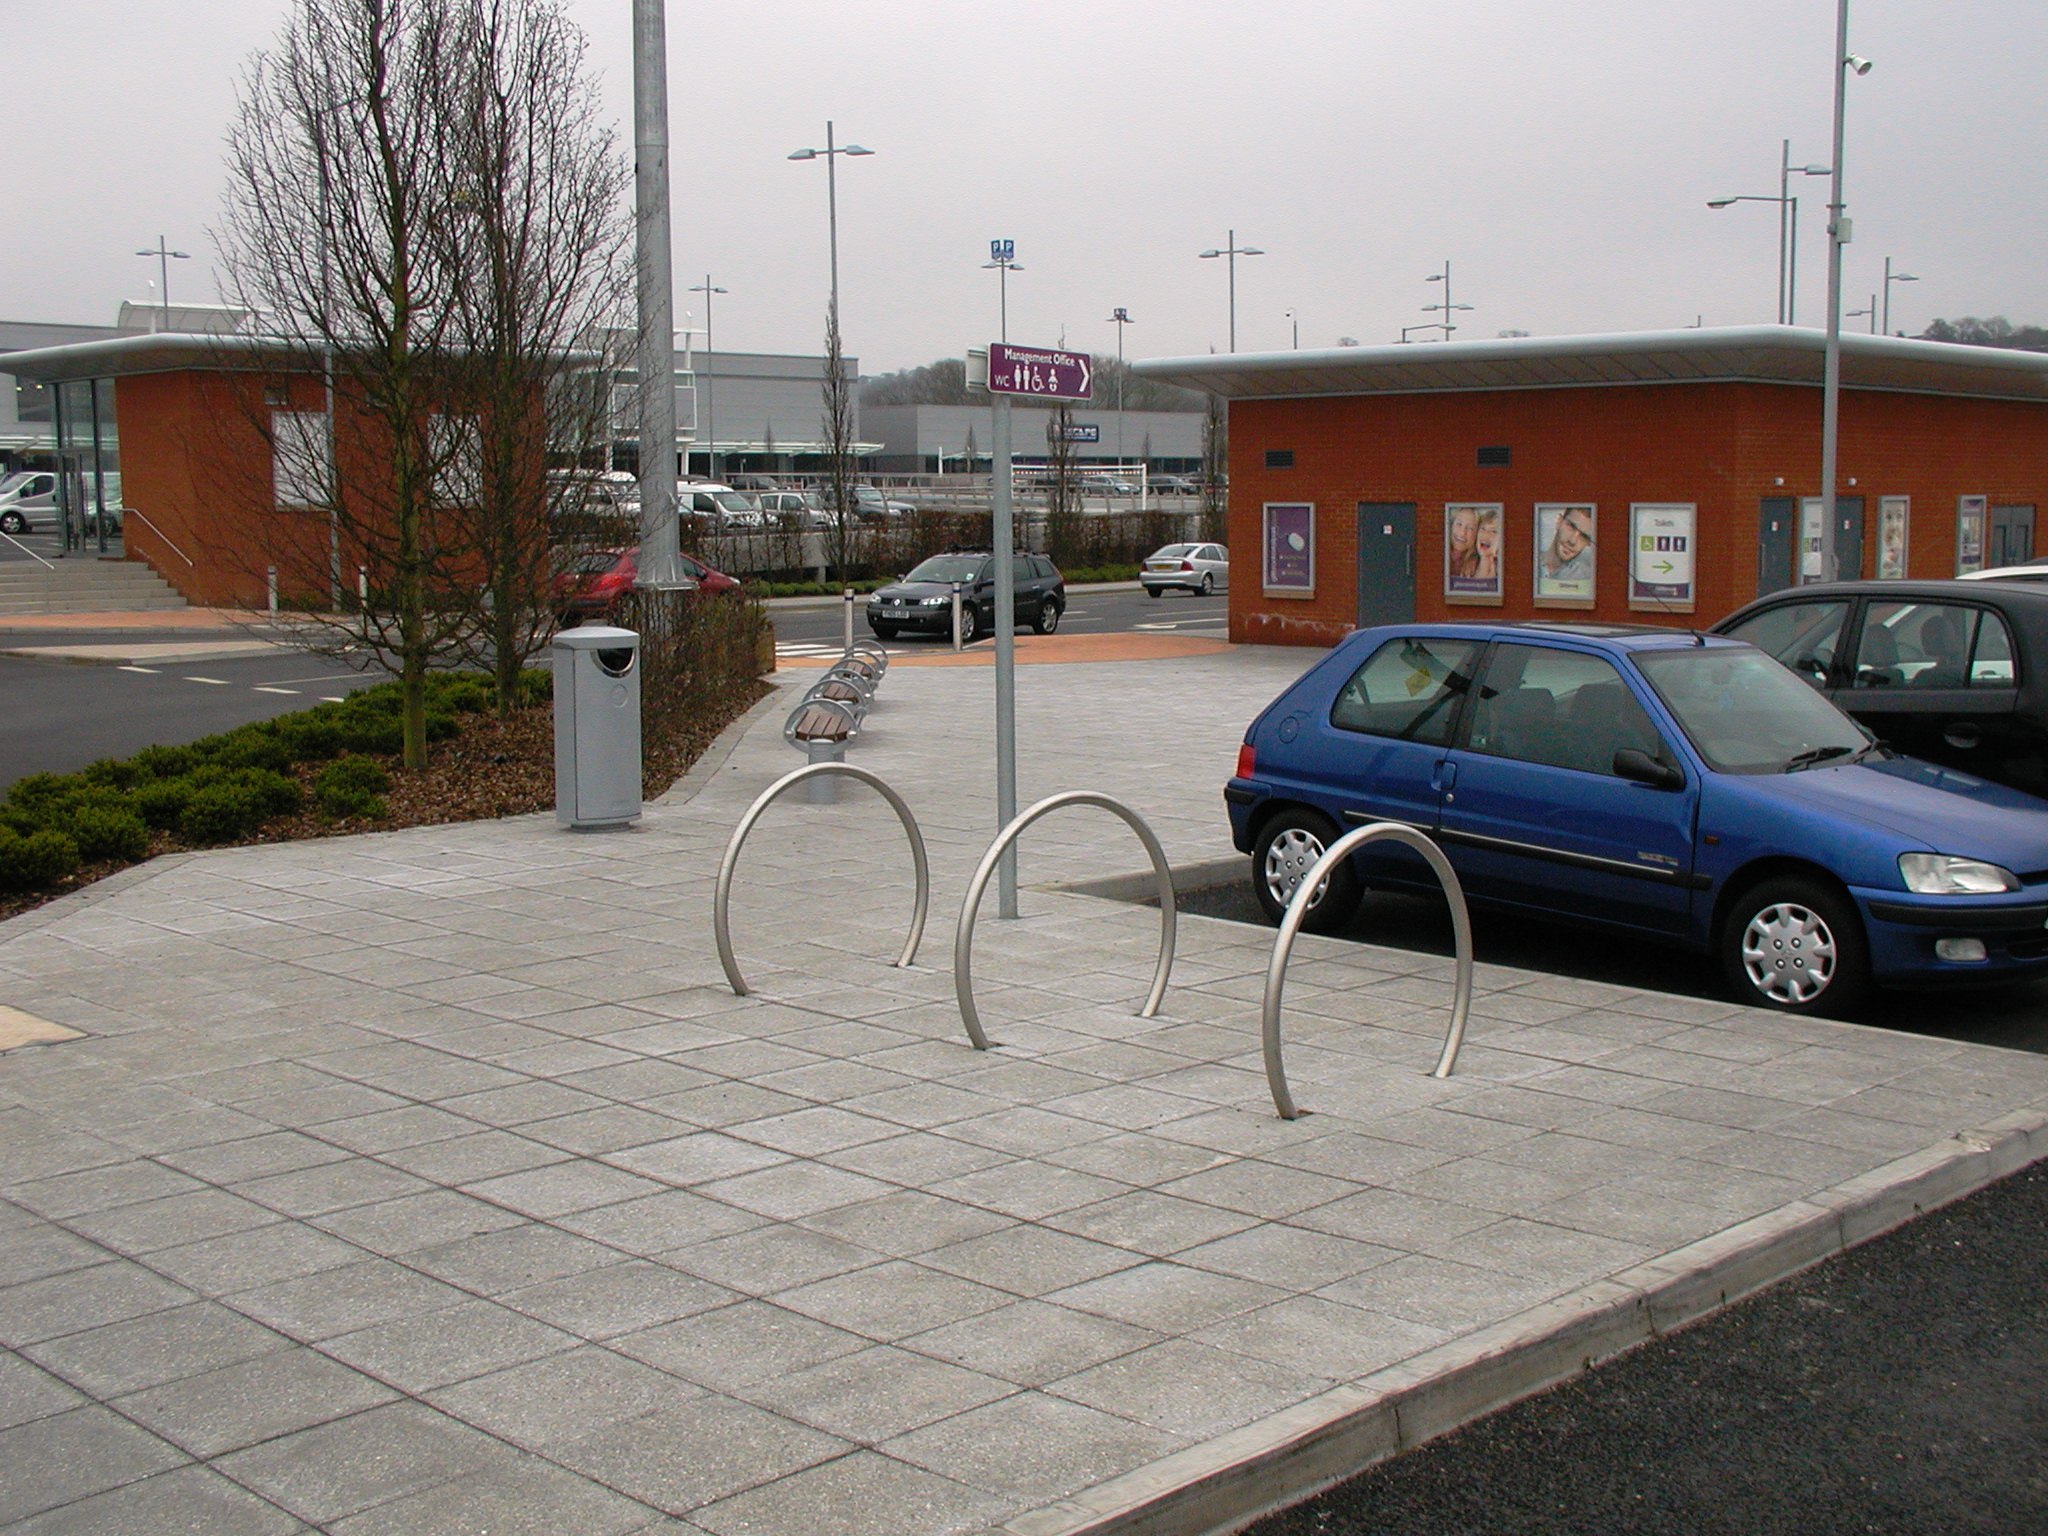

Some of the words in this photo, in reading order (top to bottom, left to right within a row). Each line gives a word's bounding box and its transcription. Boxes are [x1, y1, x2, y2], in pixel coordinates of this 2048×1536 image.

[993, 242, 999, 252] P
[1005, 241, 1012, 252] P
[1004, 348, 1052, 365] Management
[1053, 353, 1075, 367] Office
[994, 374, 1010, 387] WC
